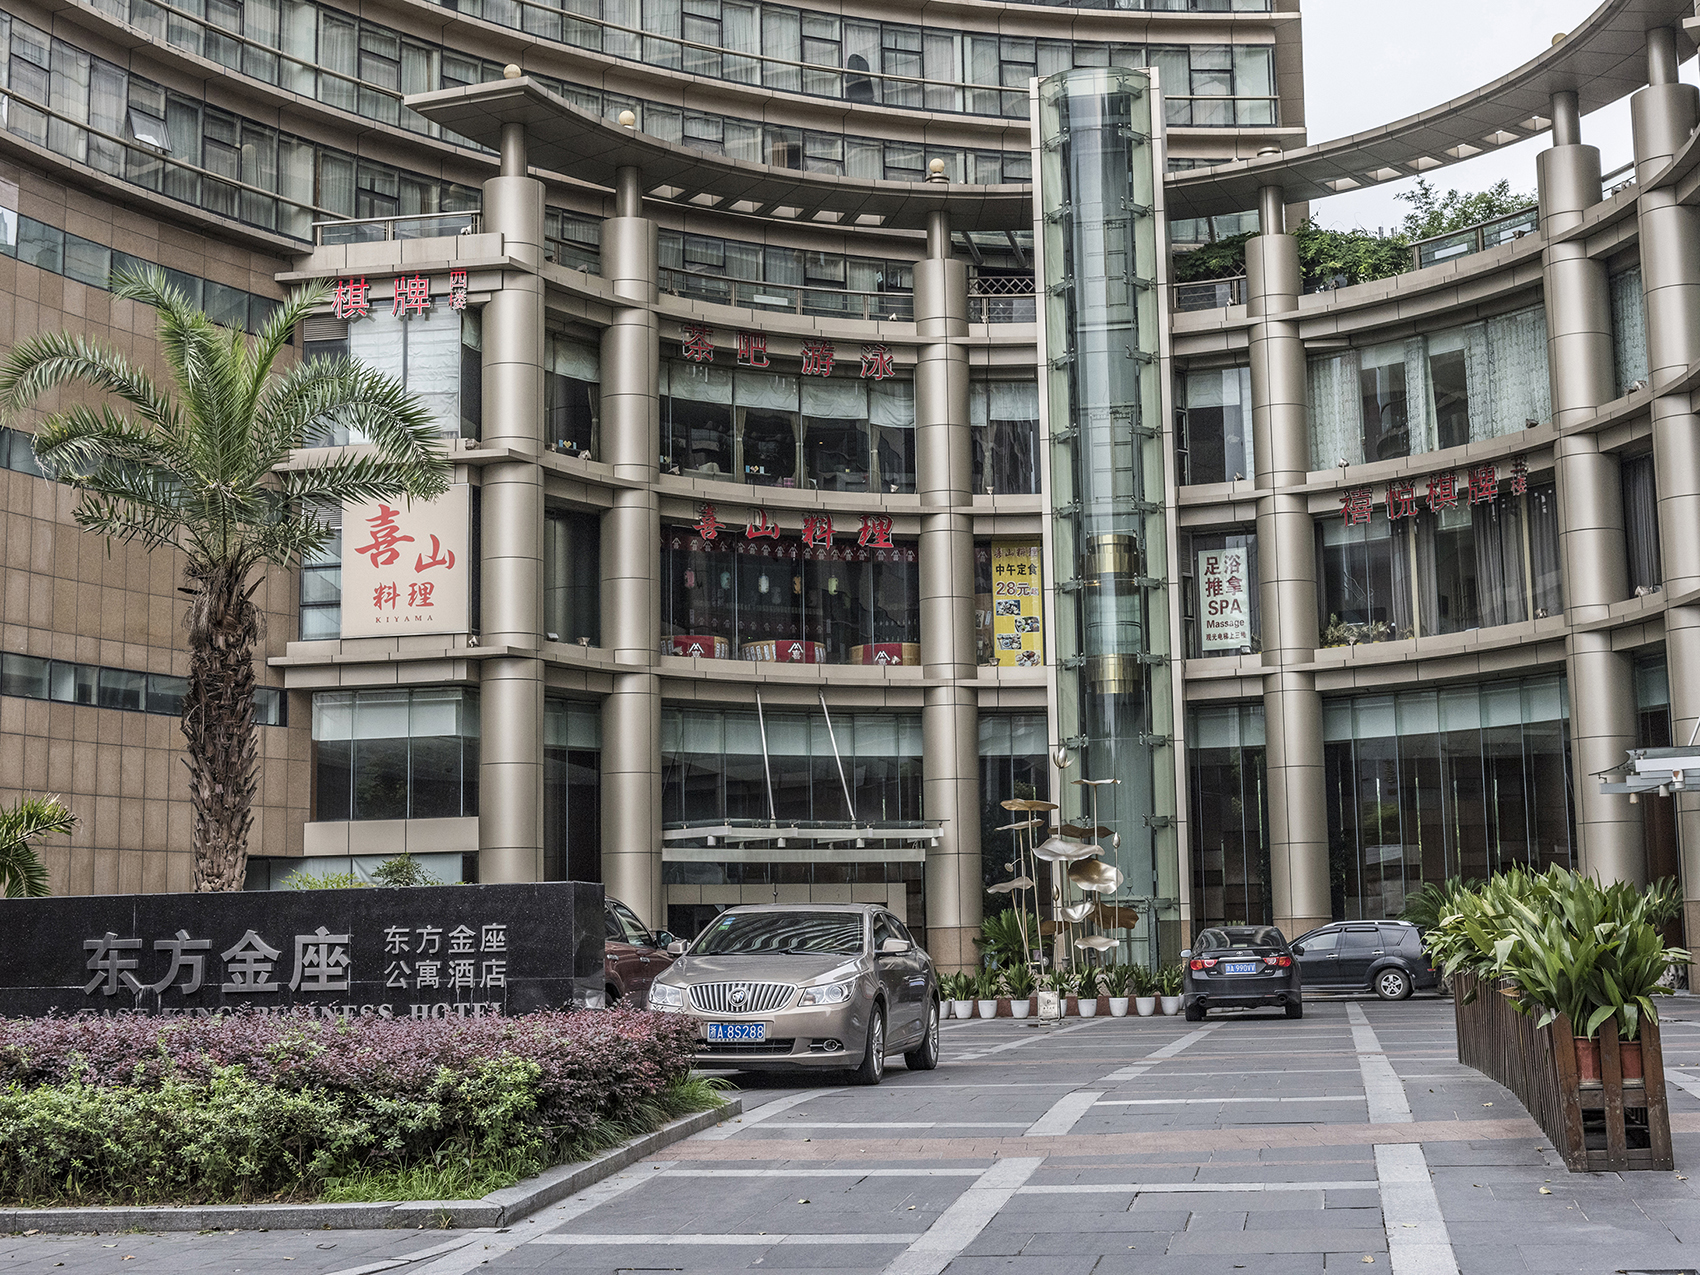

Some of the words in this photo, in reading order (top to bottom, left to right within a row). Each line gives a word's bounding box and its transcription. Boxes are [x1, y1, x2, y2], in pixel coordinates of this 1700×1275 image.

[331, 274, 432, 319] 棋牌
[447, 271, 467, 311] 四楼
[682, 325, 896, 381] 茶吧游泳
[1338, 463, 1500, 528] 禧悦棋牌
[354, 503, 456, 574] 喜山
[692, 501, 896, 550] 喜山料理
[995, 563, 1038, 577] 中午定食
[1204, 554, 1241, 577] 足浴
[372, 581, 435, 611] 料理
[1205, 575, 1243, 598] 推拿
[375, 614, 434, 624] KIYAMA
[1208, 599, 1243, 616] SPA
[1206, 619, 1245, 629] Massage
[384, 922, 508, 955] 东方金座
[83, 926, 352, 996] 东方金座
[384, 958, 508, 990] 公寓酒店
